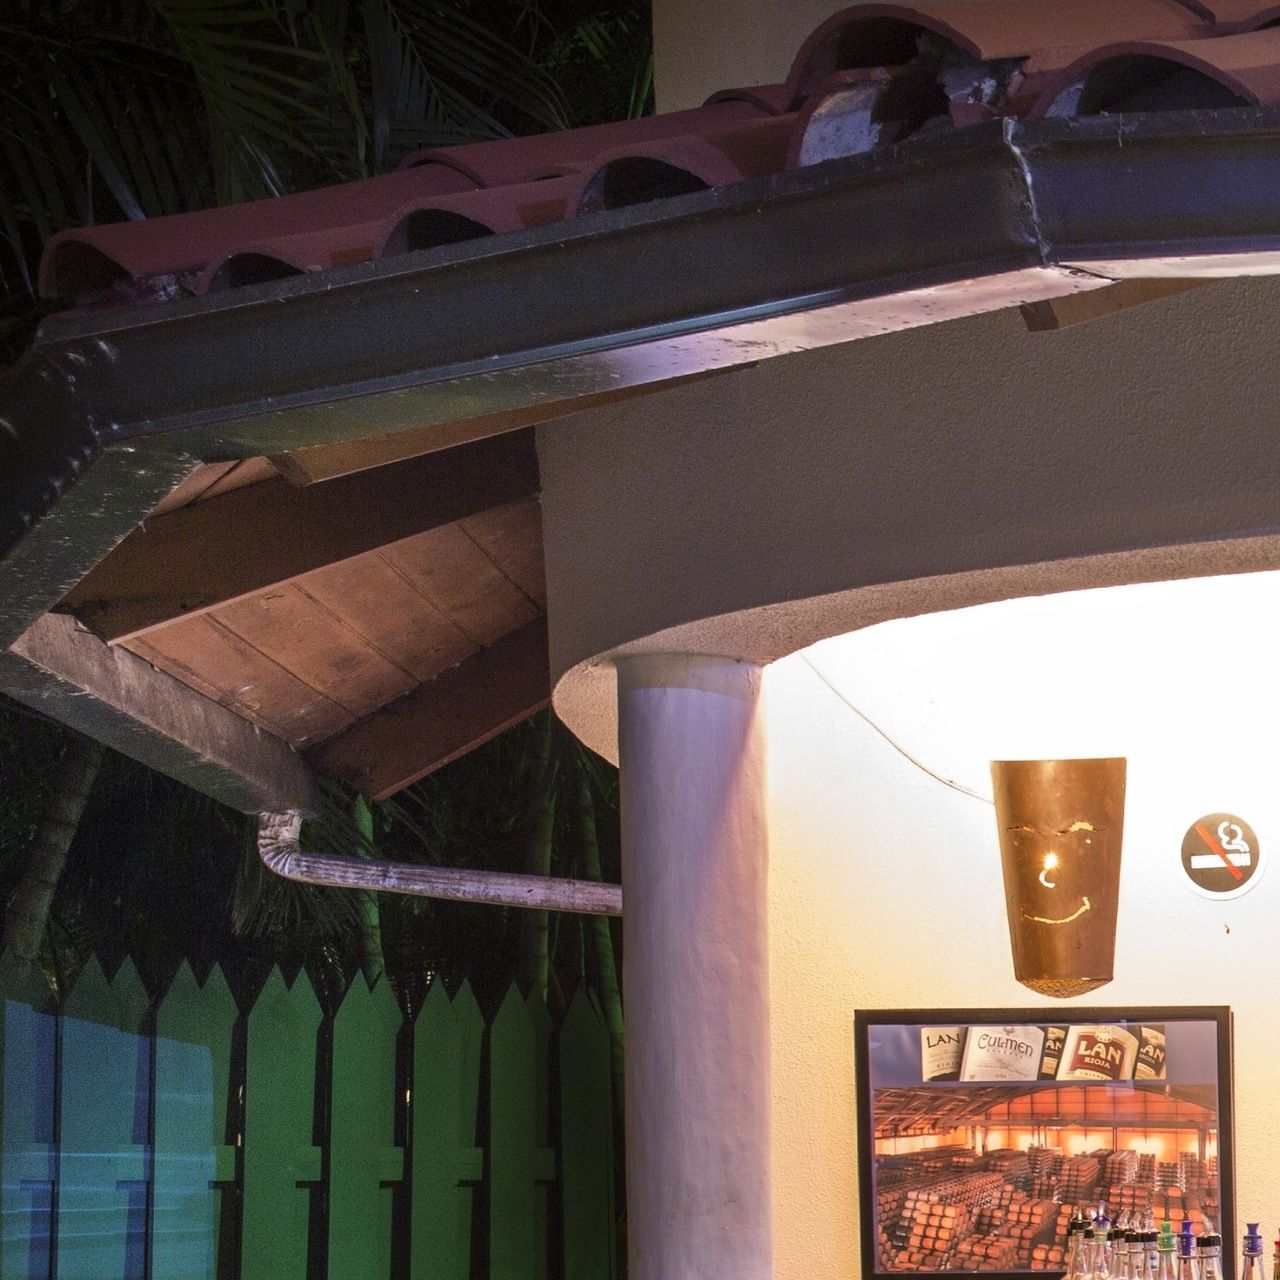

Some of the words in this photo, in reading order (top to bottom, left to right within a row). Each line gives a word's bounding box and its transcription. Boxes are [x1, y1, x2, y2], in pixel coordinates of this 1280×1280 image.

[926, 1033, 961, 1049] LAN
[978, 1033, 1034, 1057] CULMEN
[1045, 1039, 1065, 1051] AN
[1077, 1040, 1121, 1065] LAN
[1084, 1056, 1111, 1069] RIOJA
